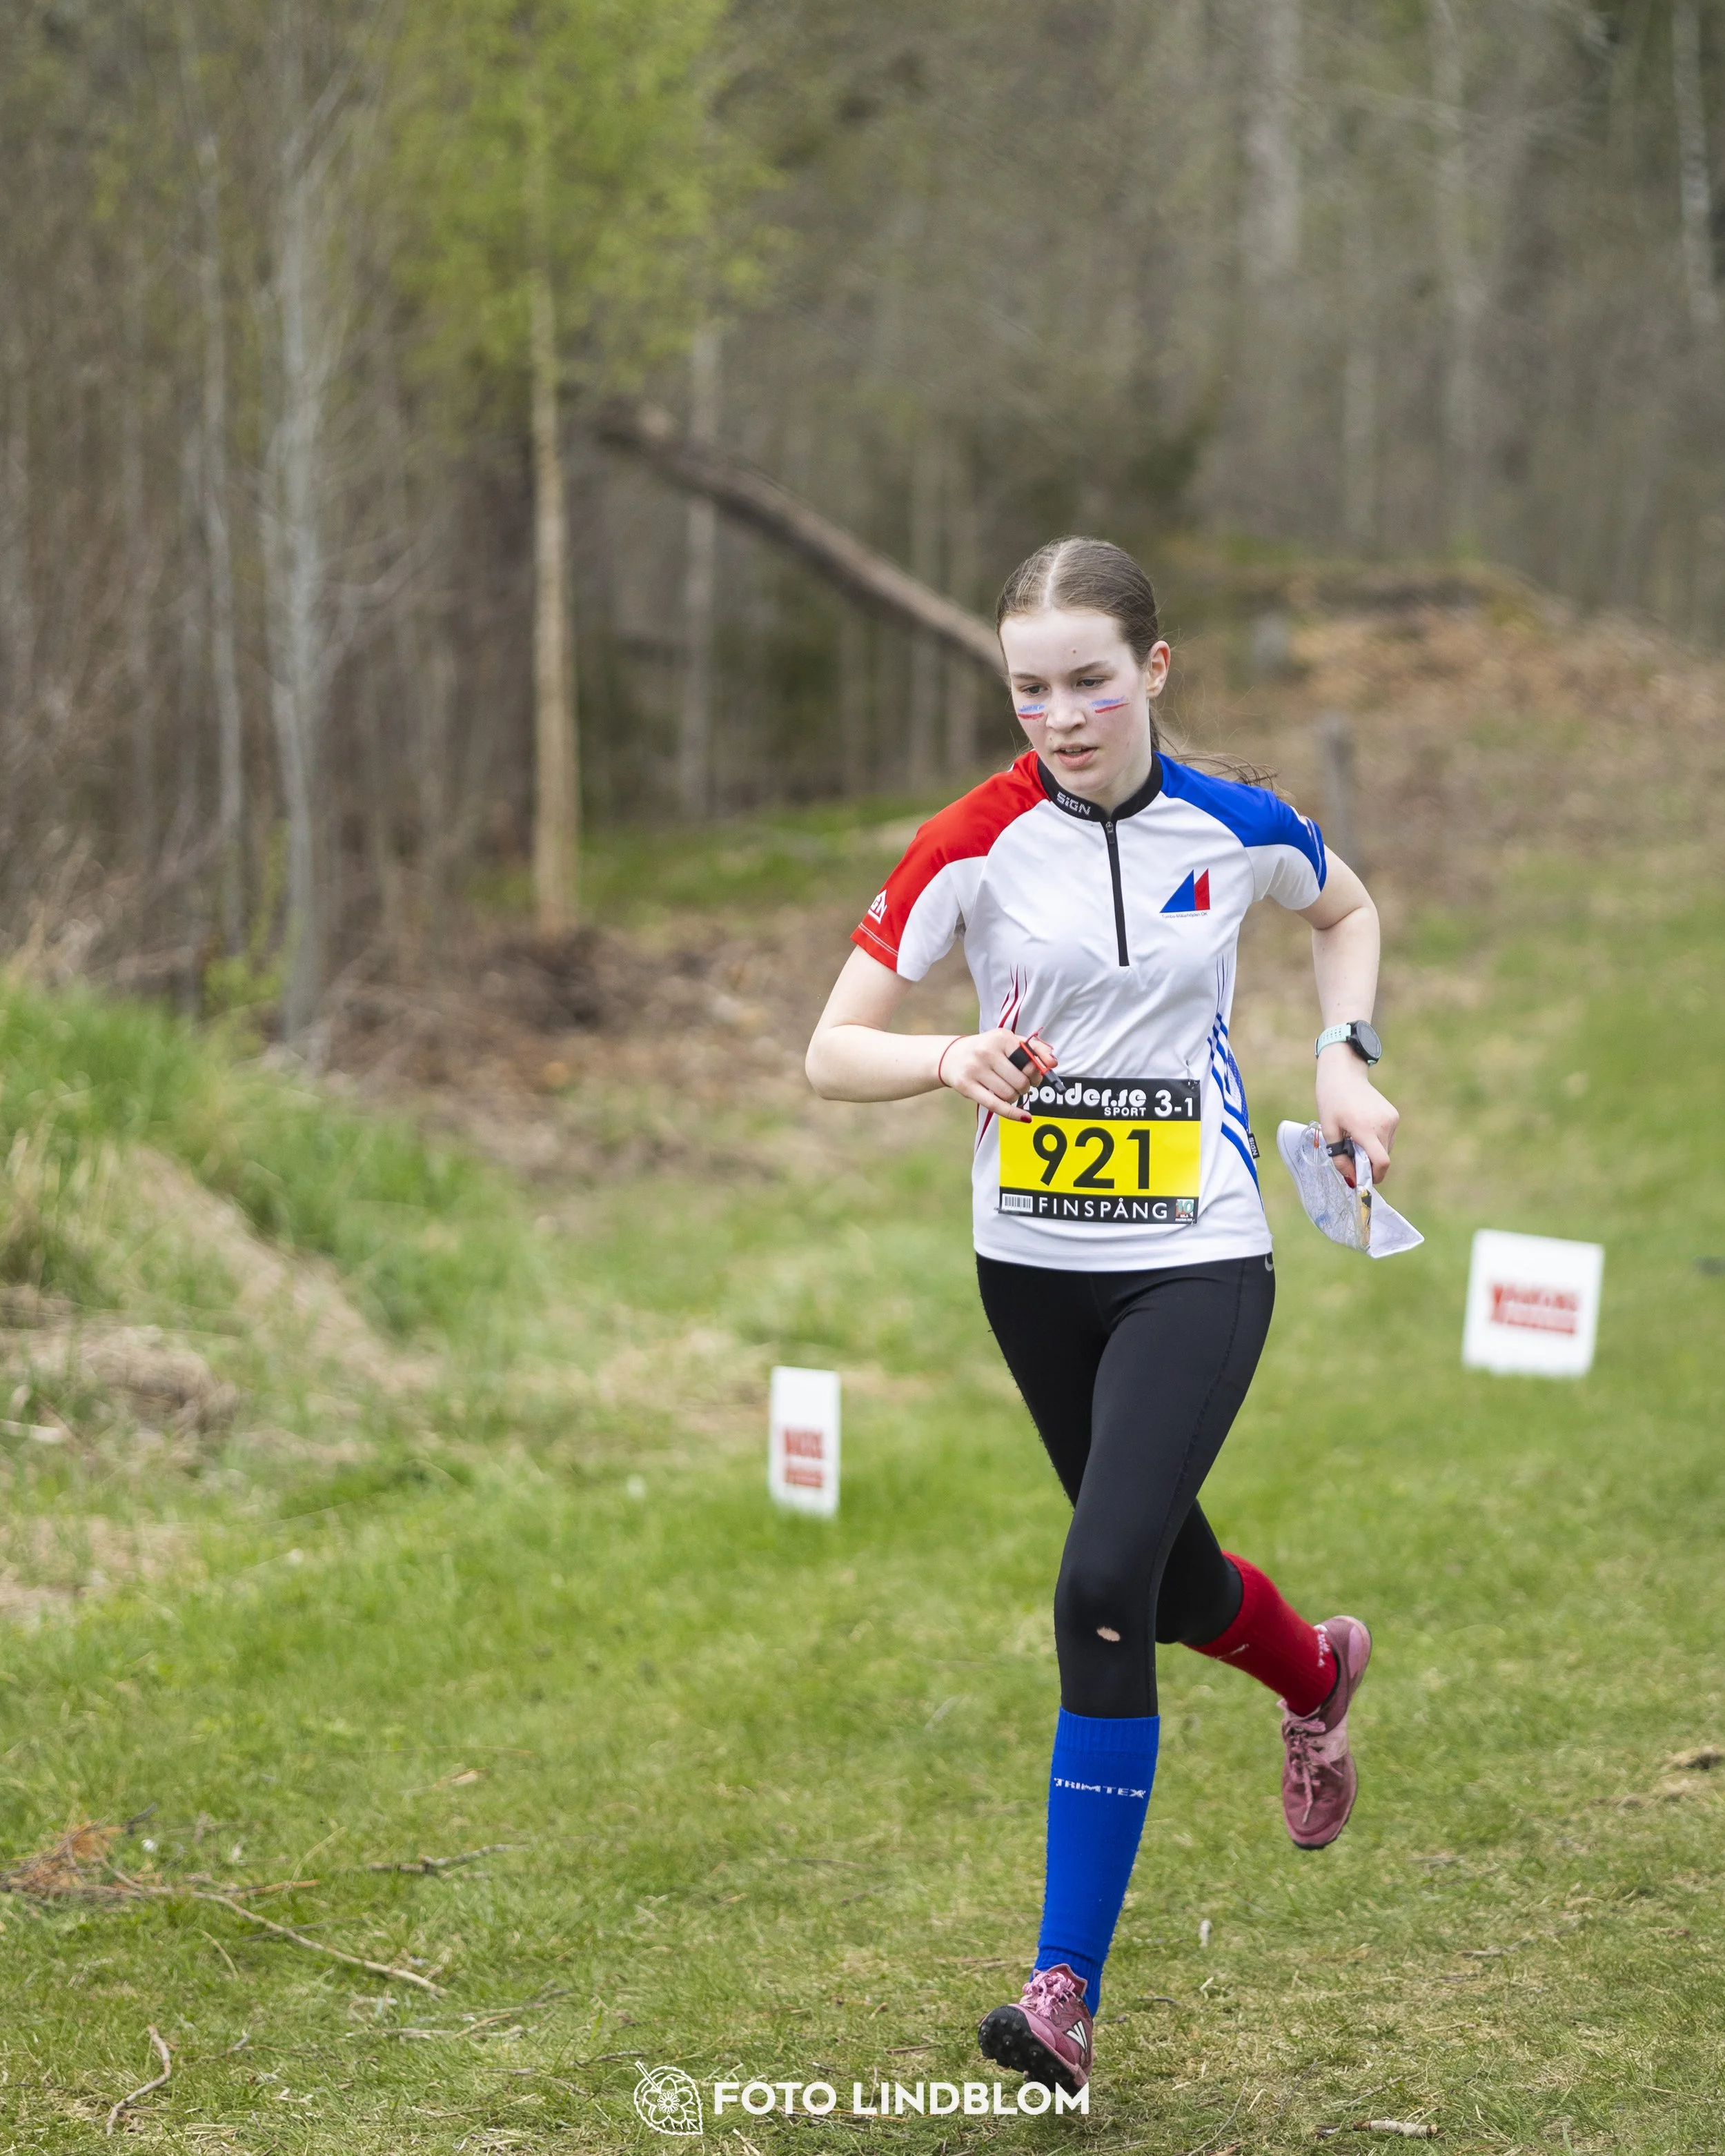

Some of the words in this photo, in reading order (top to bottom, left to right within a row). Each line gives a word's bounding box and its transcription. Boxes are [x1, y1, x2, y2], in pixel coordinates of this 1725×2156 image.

[1104, 1107, 1146, 1116] SPORT
[1154, 1089, 1193, 1116] 3-1
[1032, 1123, 1150, 1189] 921
[1038, 1197, 1167, 1219] FINSPÅNG
[1054, 1777, 1146, 1799] TRIMTEX
